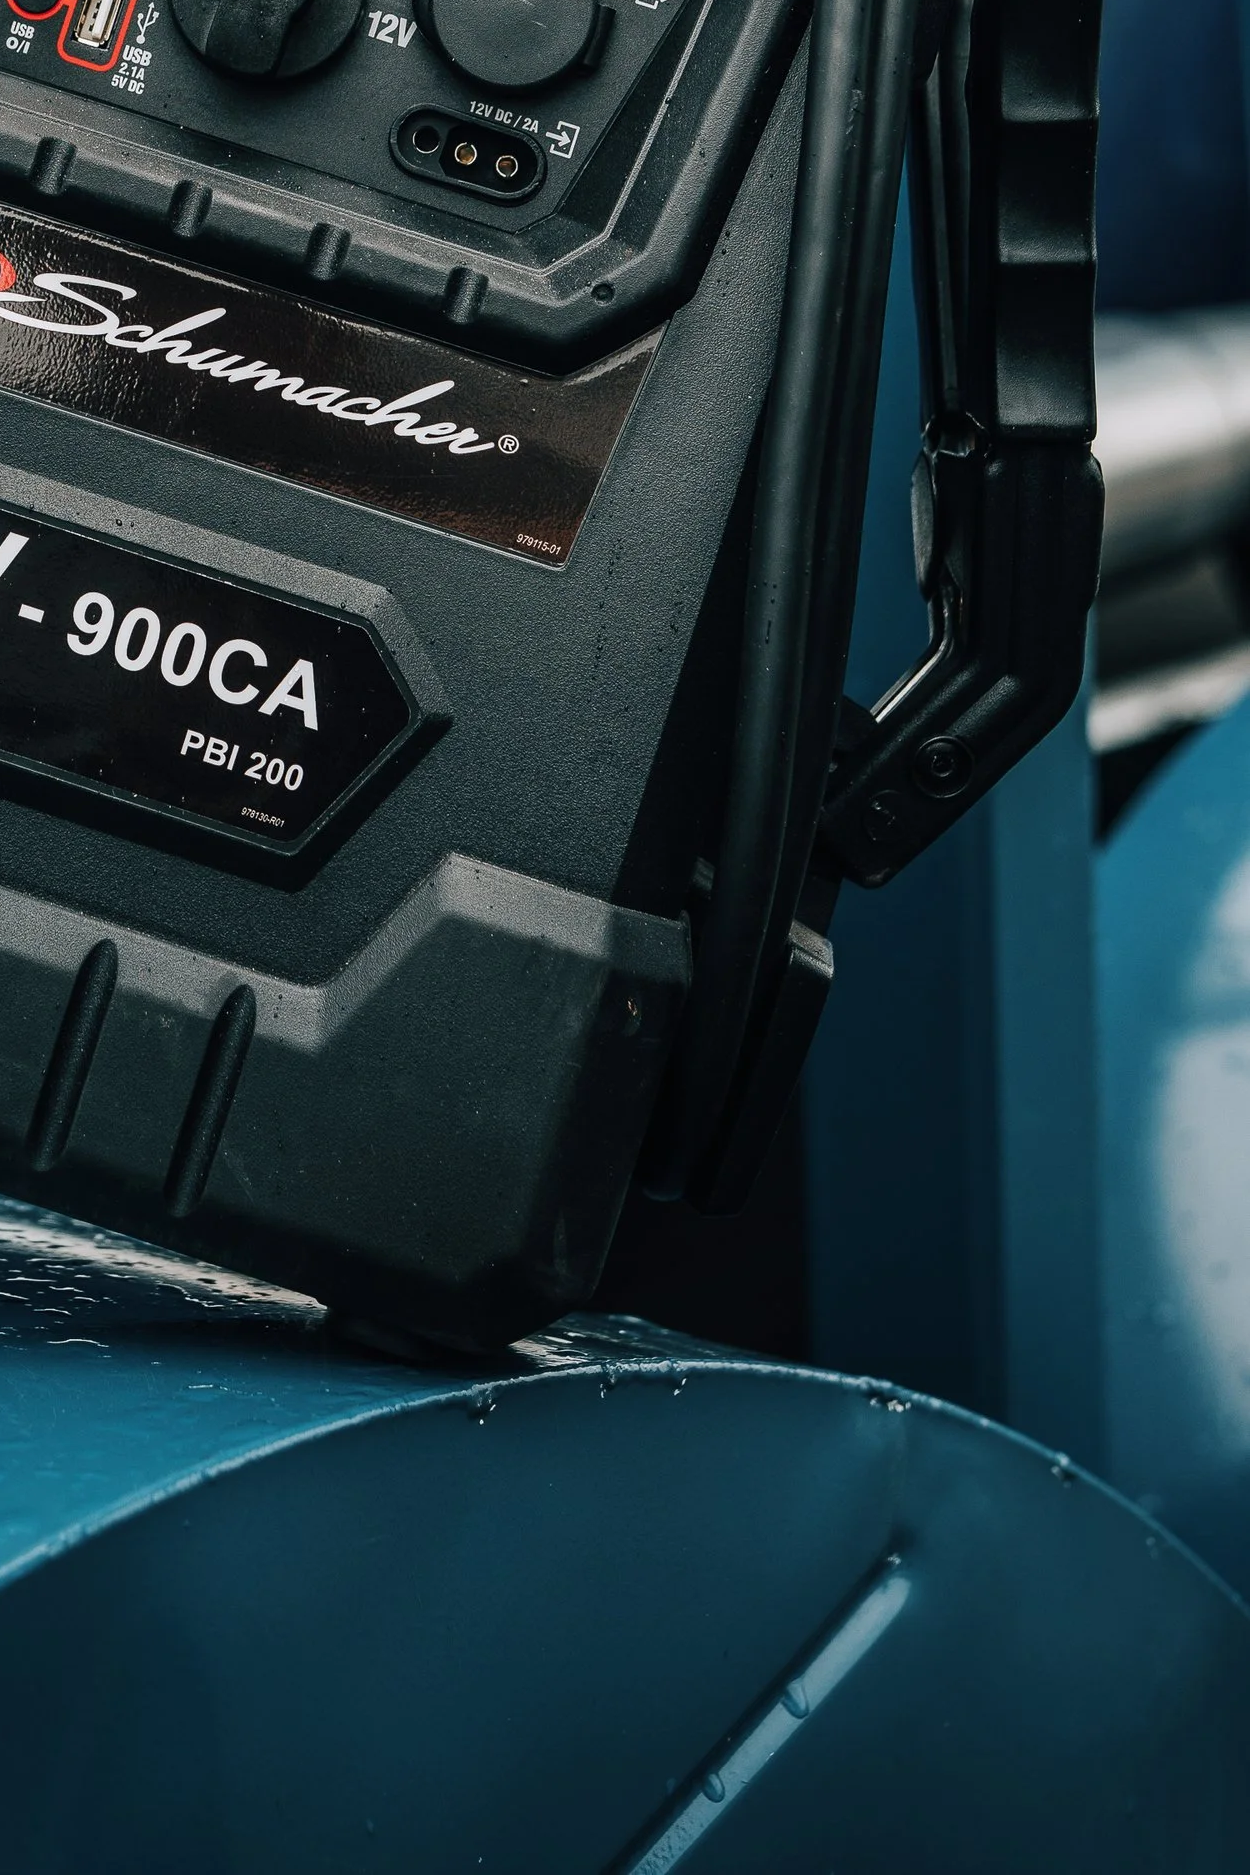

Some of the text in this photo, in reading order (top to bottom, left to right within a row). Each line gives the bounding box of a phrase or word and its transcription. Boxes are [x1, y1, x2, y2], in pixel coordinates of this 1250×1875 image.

[10, 21, 35, 39] USB
[368, 10, 417, 48] 12V
[122, 45, 152, 67] USB
[118, 62, 145, 81] 2.1A
[111, 75, 145, 95] 5V DC
[469, 100, 494, 118] 12V
[494, 108, 513, 125] DC
[524, 118, 539, 134] 2A
[516, 533, 562, 556] 979115-01
[66, 591, 320, 731] 900CA
[180, 729, 304, 791] PBI 200
[240, 806, 285, 828] 978130-R01
